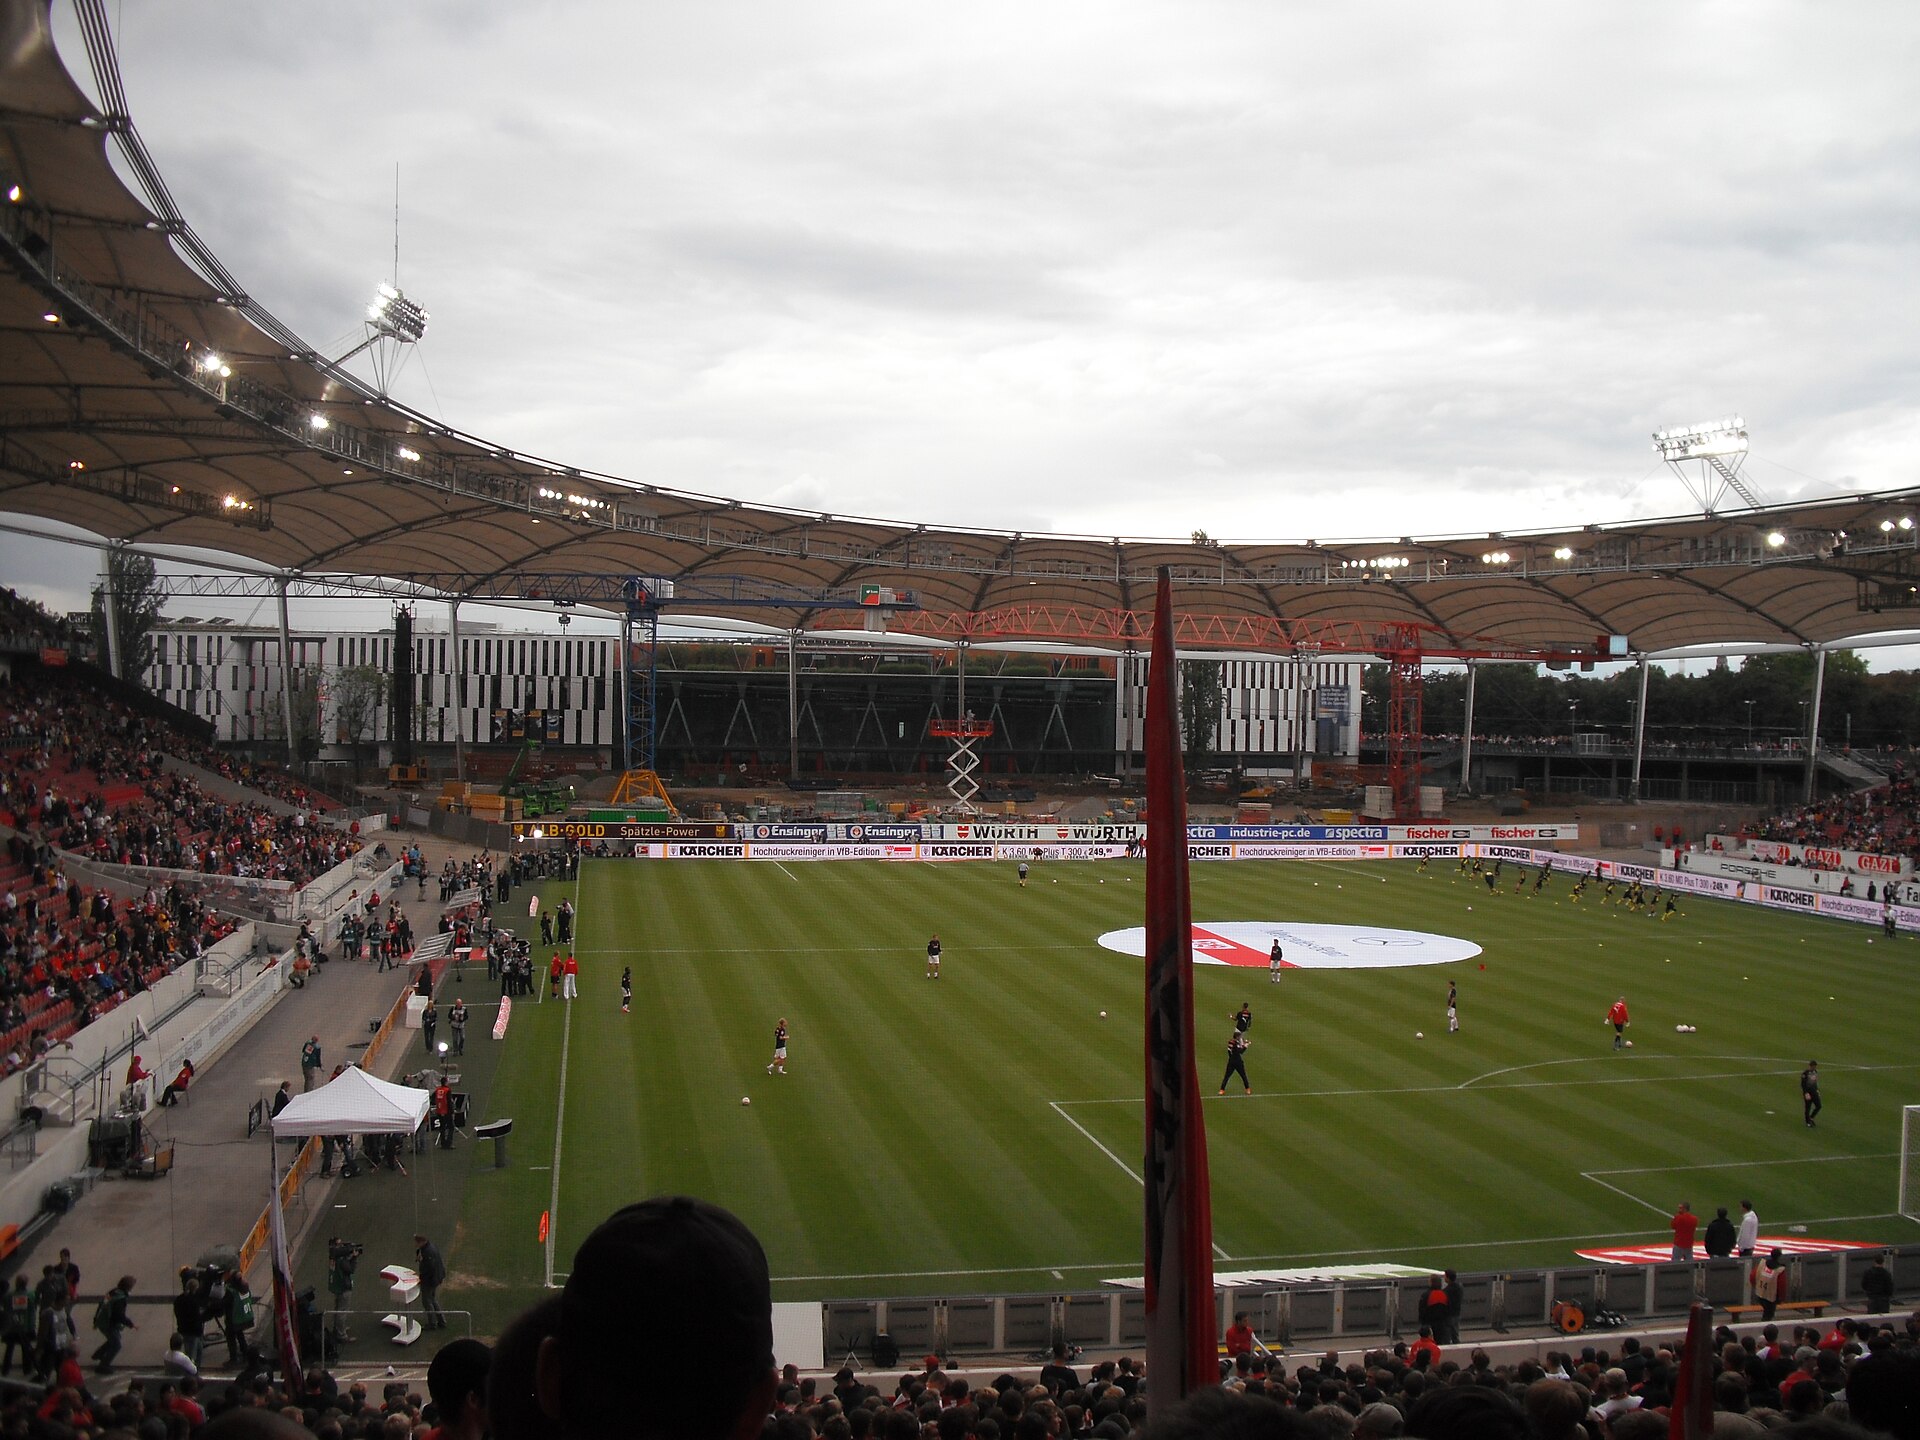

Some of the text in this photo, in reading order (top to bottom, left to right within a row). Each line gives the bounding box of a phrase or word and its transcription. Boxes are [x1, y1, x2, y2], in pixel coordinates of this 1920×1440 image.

[619, 825, 700, 838] Spätzle-Power
[771, 826, 825, 839] Ensinger
[864, 826, 918, 838] Ensinger
[973, 825, 1039, 839] WÜRTH
[1073, 825, 1137, 839] WÜRTH
[1187, 826, 1383, 839] ctra industrie-pc.de spectra
[1406, 827, 1450, 839] fischer
[1490, 826, 1536, 838] fischer
[679, 845, 743, 856] KÄRCHER
[753, 846, 826, 859] Hochdruckreiniger
[827, 846, 836, 857] in
[837, 845, 881, 857] VfB-Edition
[931, 845, 993, 857] KÄRCHER
[1061, 848, 1066, 856] T
[1066, 847, 1082, 856] 300
[1189, 846, 1231, 857] RCHER
[1239, 847, 1305, 858] Hochdruckreiniger
[1306, 847, 1314, 857] in
[1316, 847, 1357, 857] VfB-Edition
[1403, 846, 1458, 857] KÄRCHER
[1489, 847, 1531, 860] KÄRCHER
[1807, 848, 1839, 866] GAZI
[1861, 856, 1894, 872] GAZI
[1620, 865, 1655, 881] KÄRCHER
[1720, 863, 1777, 879] PORSCHE
[1770, 888, 1815, 907] KÄRCHER
[1907, 886, 1920, 902] Fa
